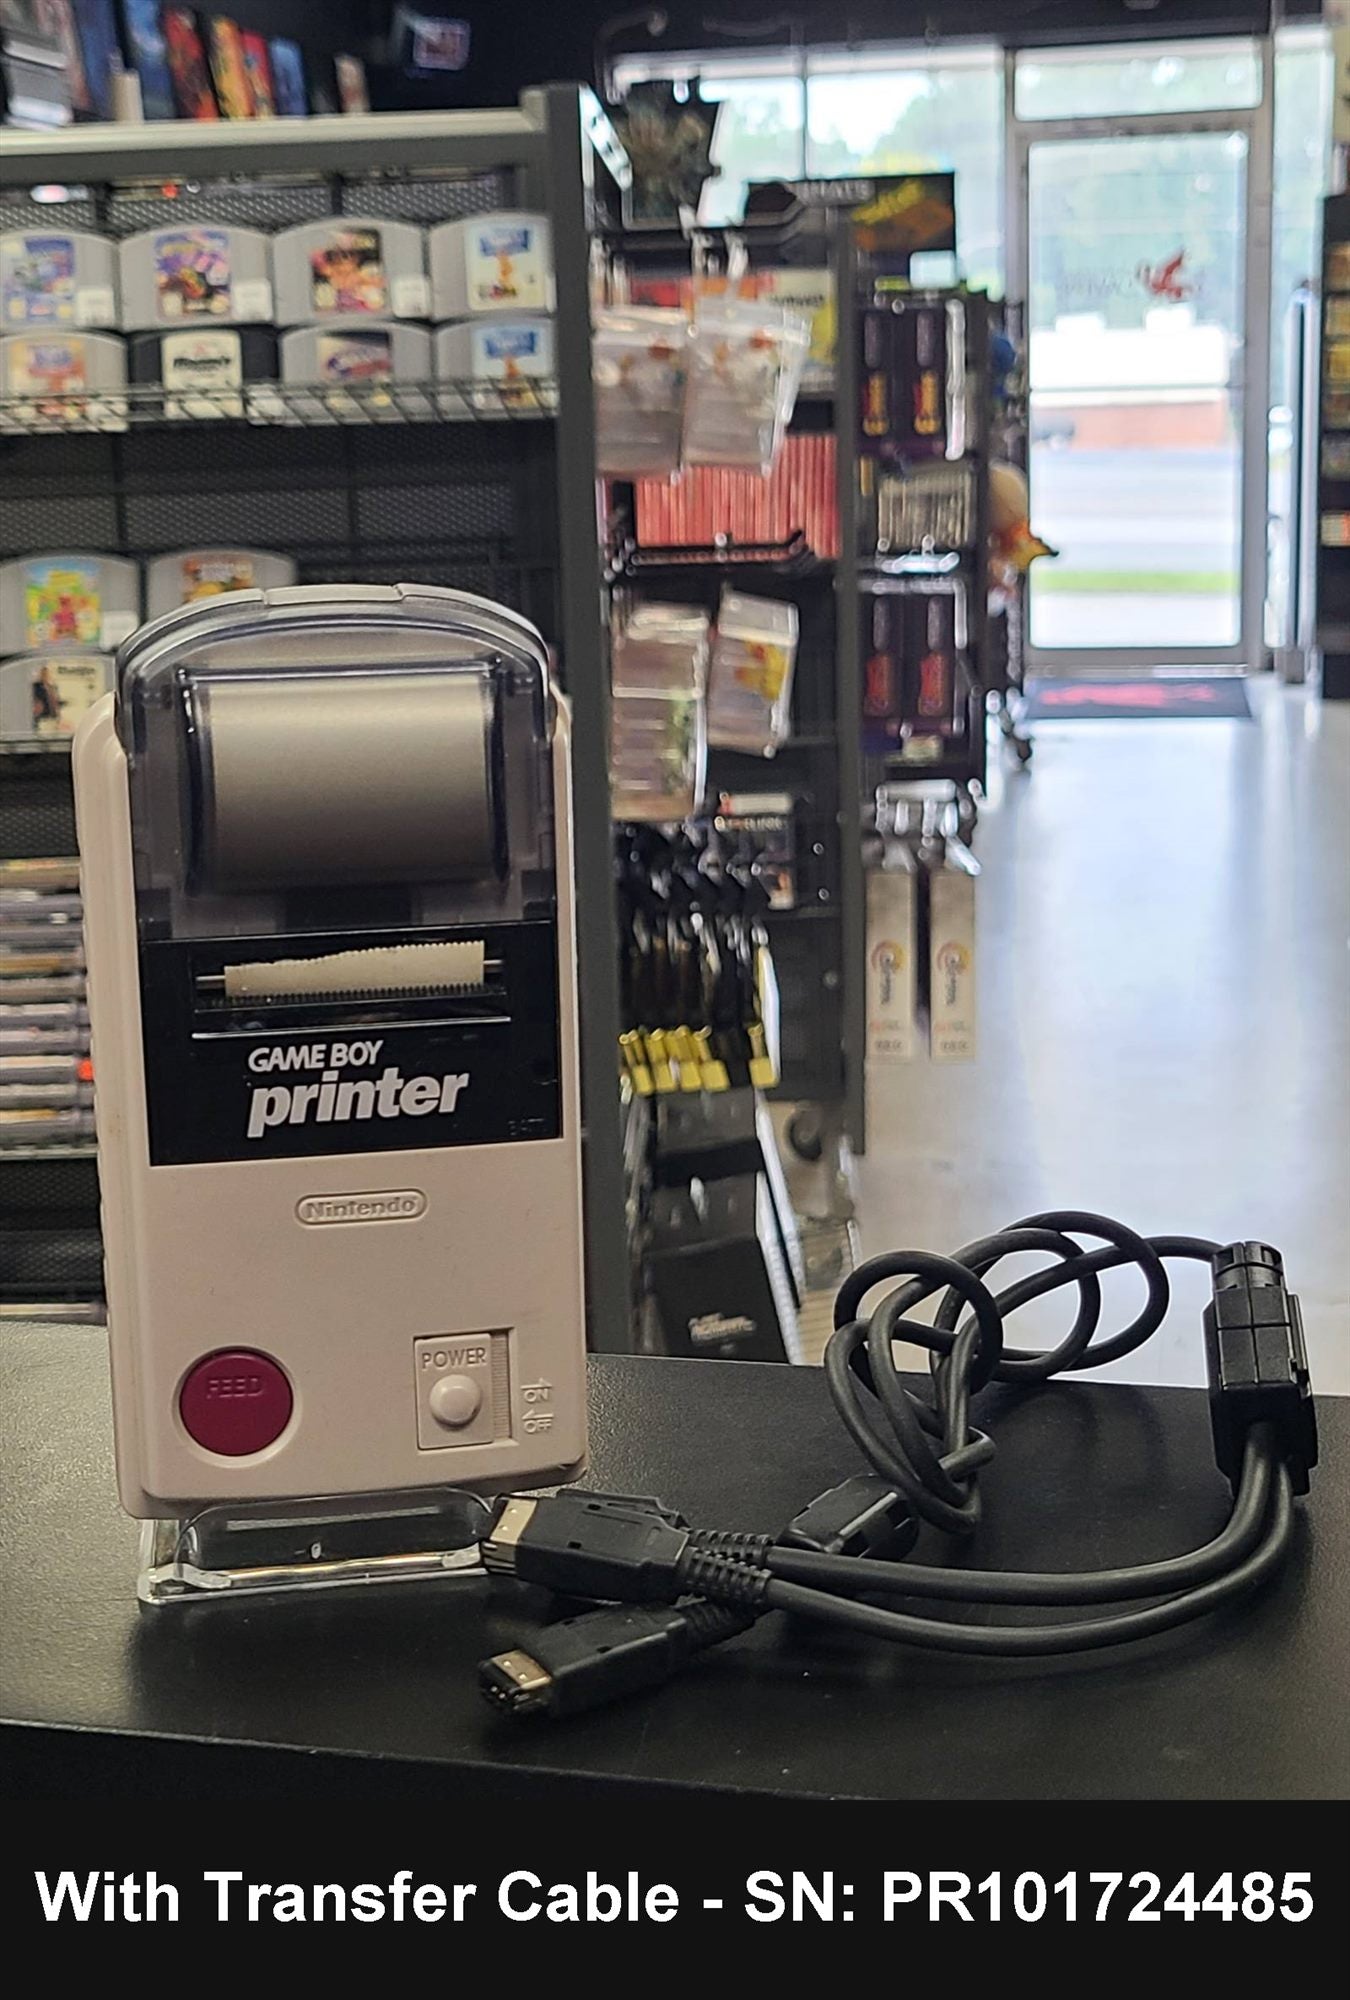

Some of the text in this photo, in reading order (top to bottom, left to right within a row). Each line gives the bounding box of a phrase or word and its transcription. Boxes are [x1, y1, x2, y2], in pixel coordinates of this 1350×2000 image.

[248, 1040, 384, 1072] GAME BOY
[247, 1067, 470, 1138] printer
[306, 1196, 416, 1219] Nintendo
[421, 1347, 487, 1370] POWER
[206, 1378, 264, 1399] FEED
[524, 1388, 549, 1404] ON
[524, 1418, 553, 1434] OFF
